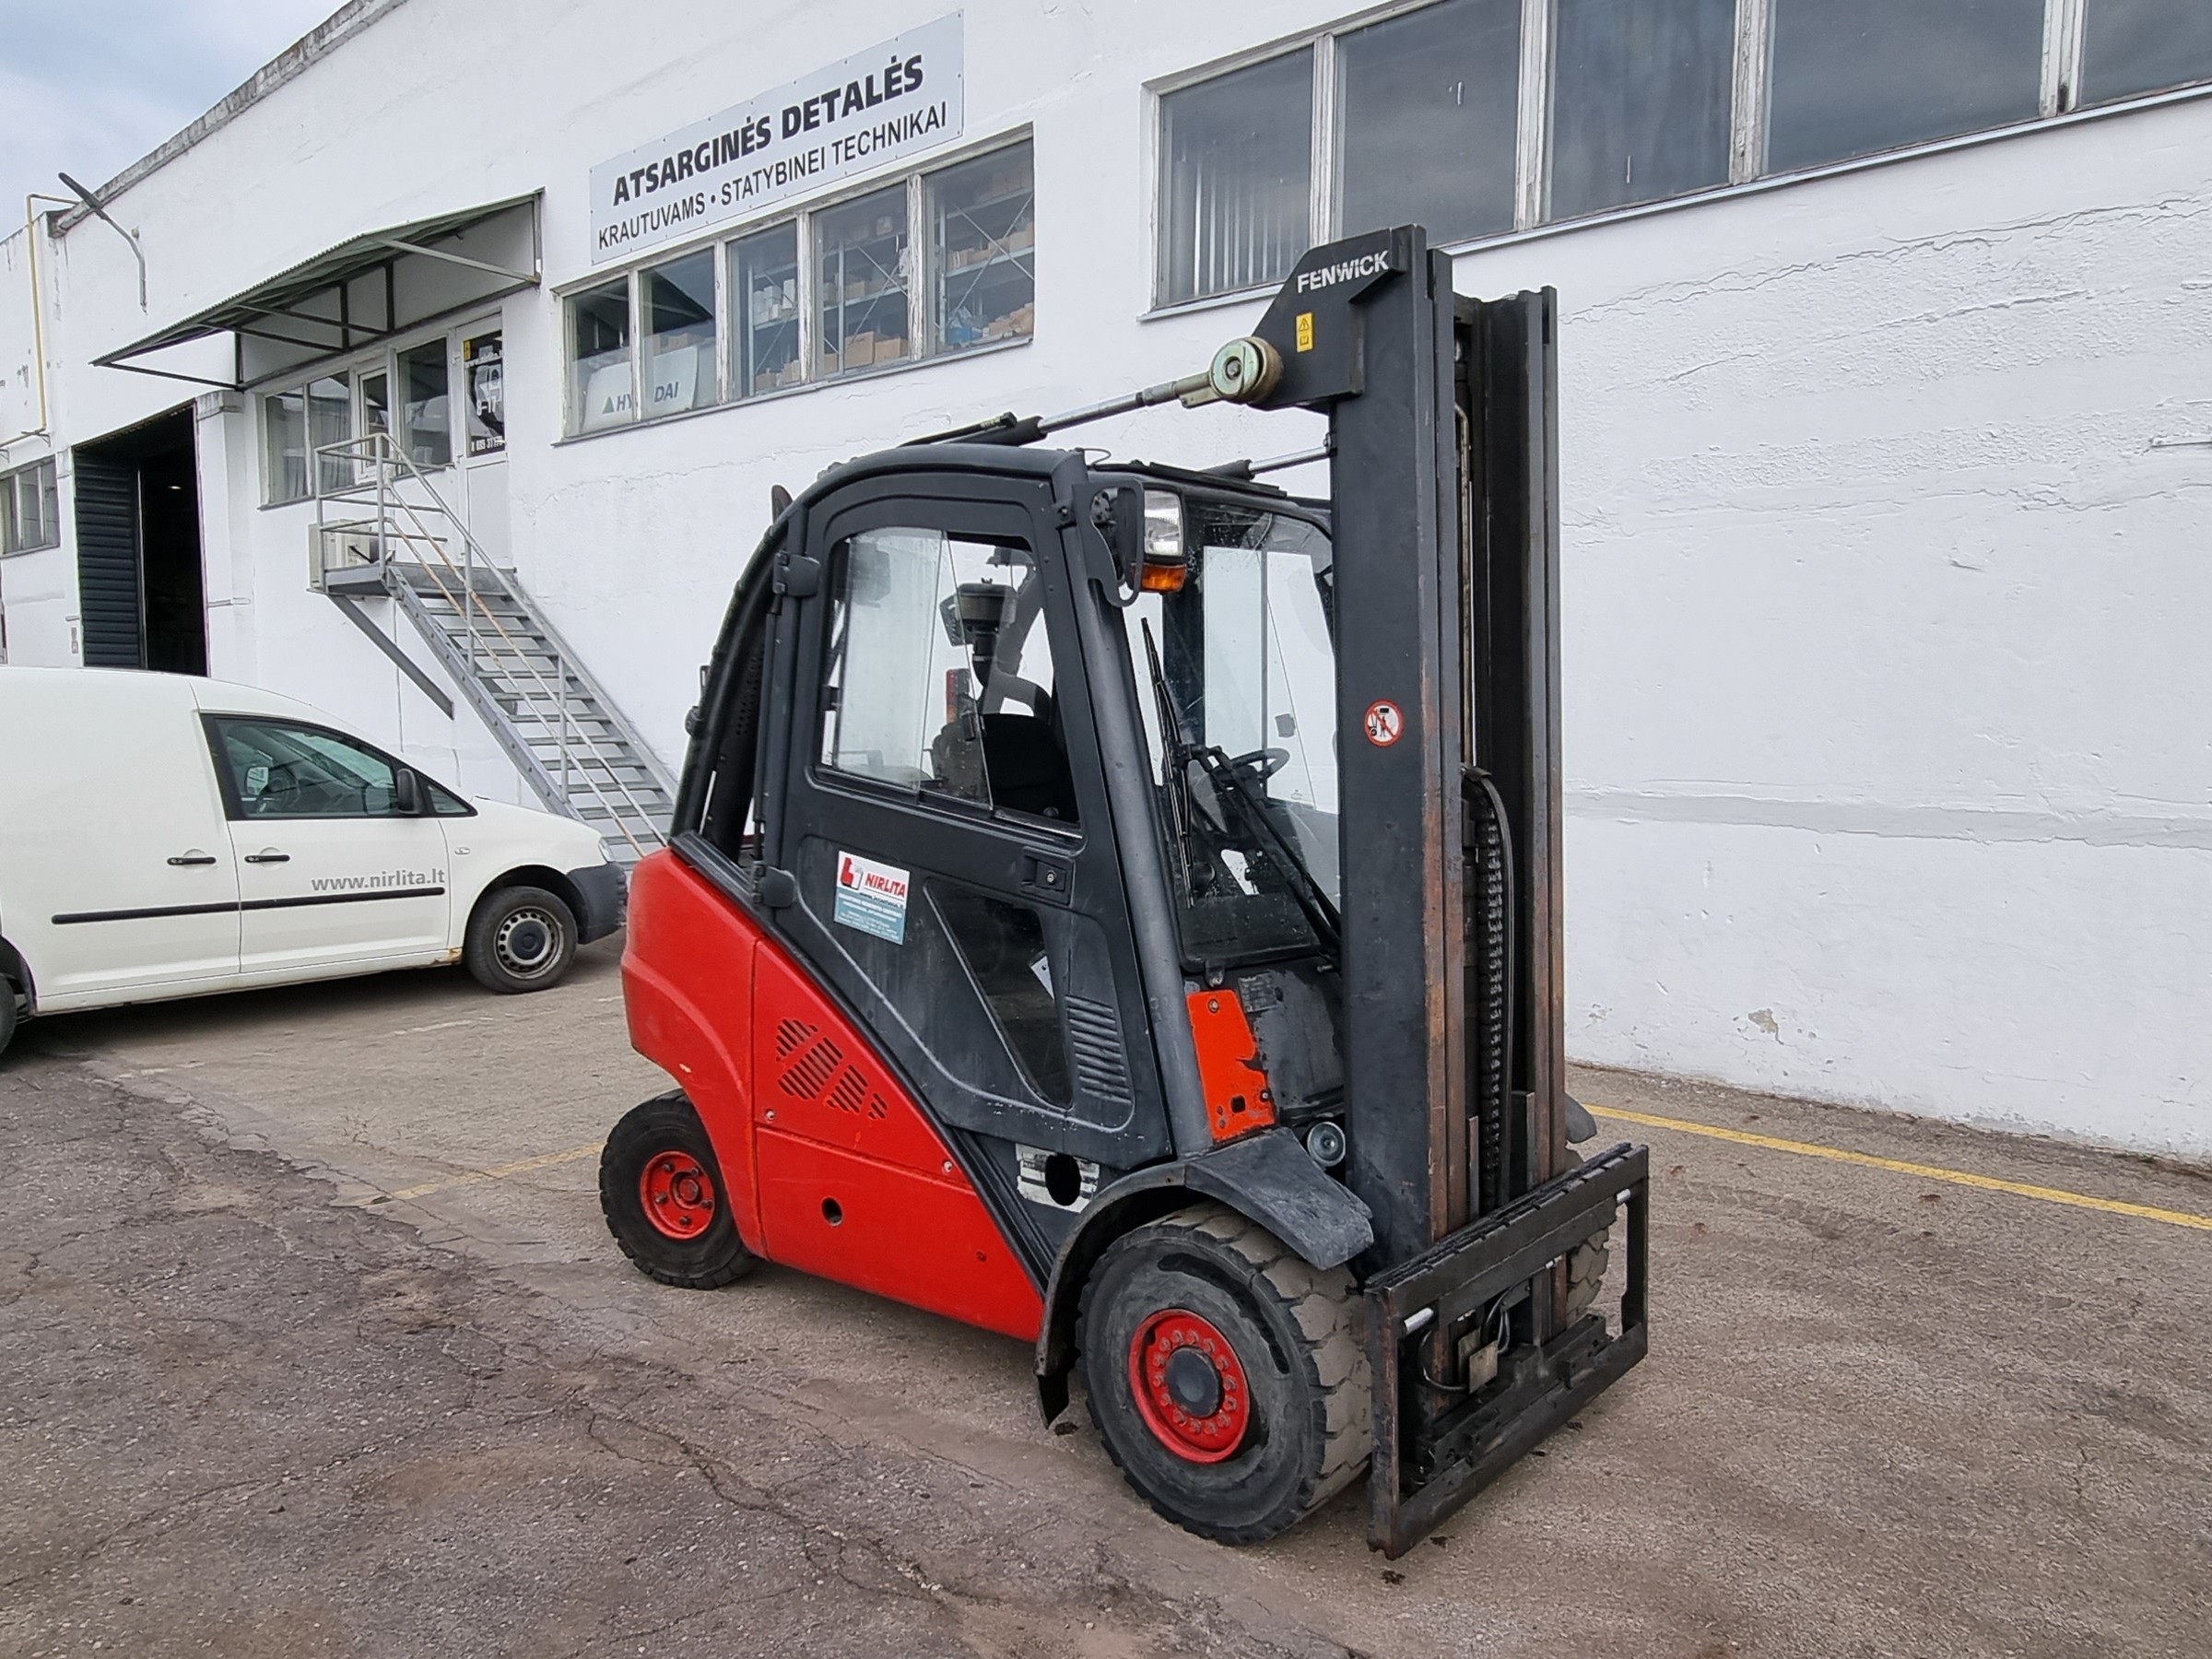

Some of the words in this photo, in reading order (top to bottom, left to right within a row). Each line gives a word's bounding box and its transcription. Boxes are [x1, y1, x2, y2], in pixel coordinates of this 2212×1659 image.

[613, 116, 771, 206] ATSARGINĖS
[782, 53, 924, 139] DETALĖS
[598, 192, 706, 250] KRAUTUVAMS
[721, 147, 826, 206] STATYBINEI
[830, 100, 947, 166] TECHNIKAI
[1297, 250, 1390, 294] FENWICK
[617, 382, 679, 412] HYDAI
[312, 868, 444, 890] www.nirlita.lt
[865, 873, 905, 897] NIRLITA
